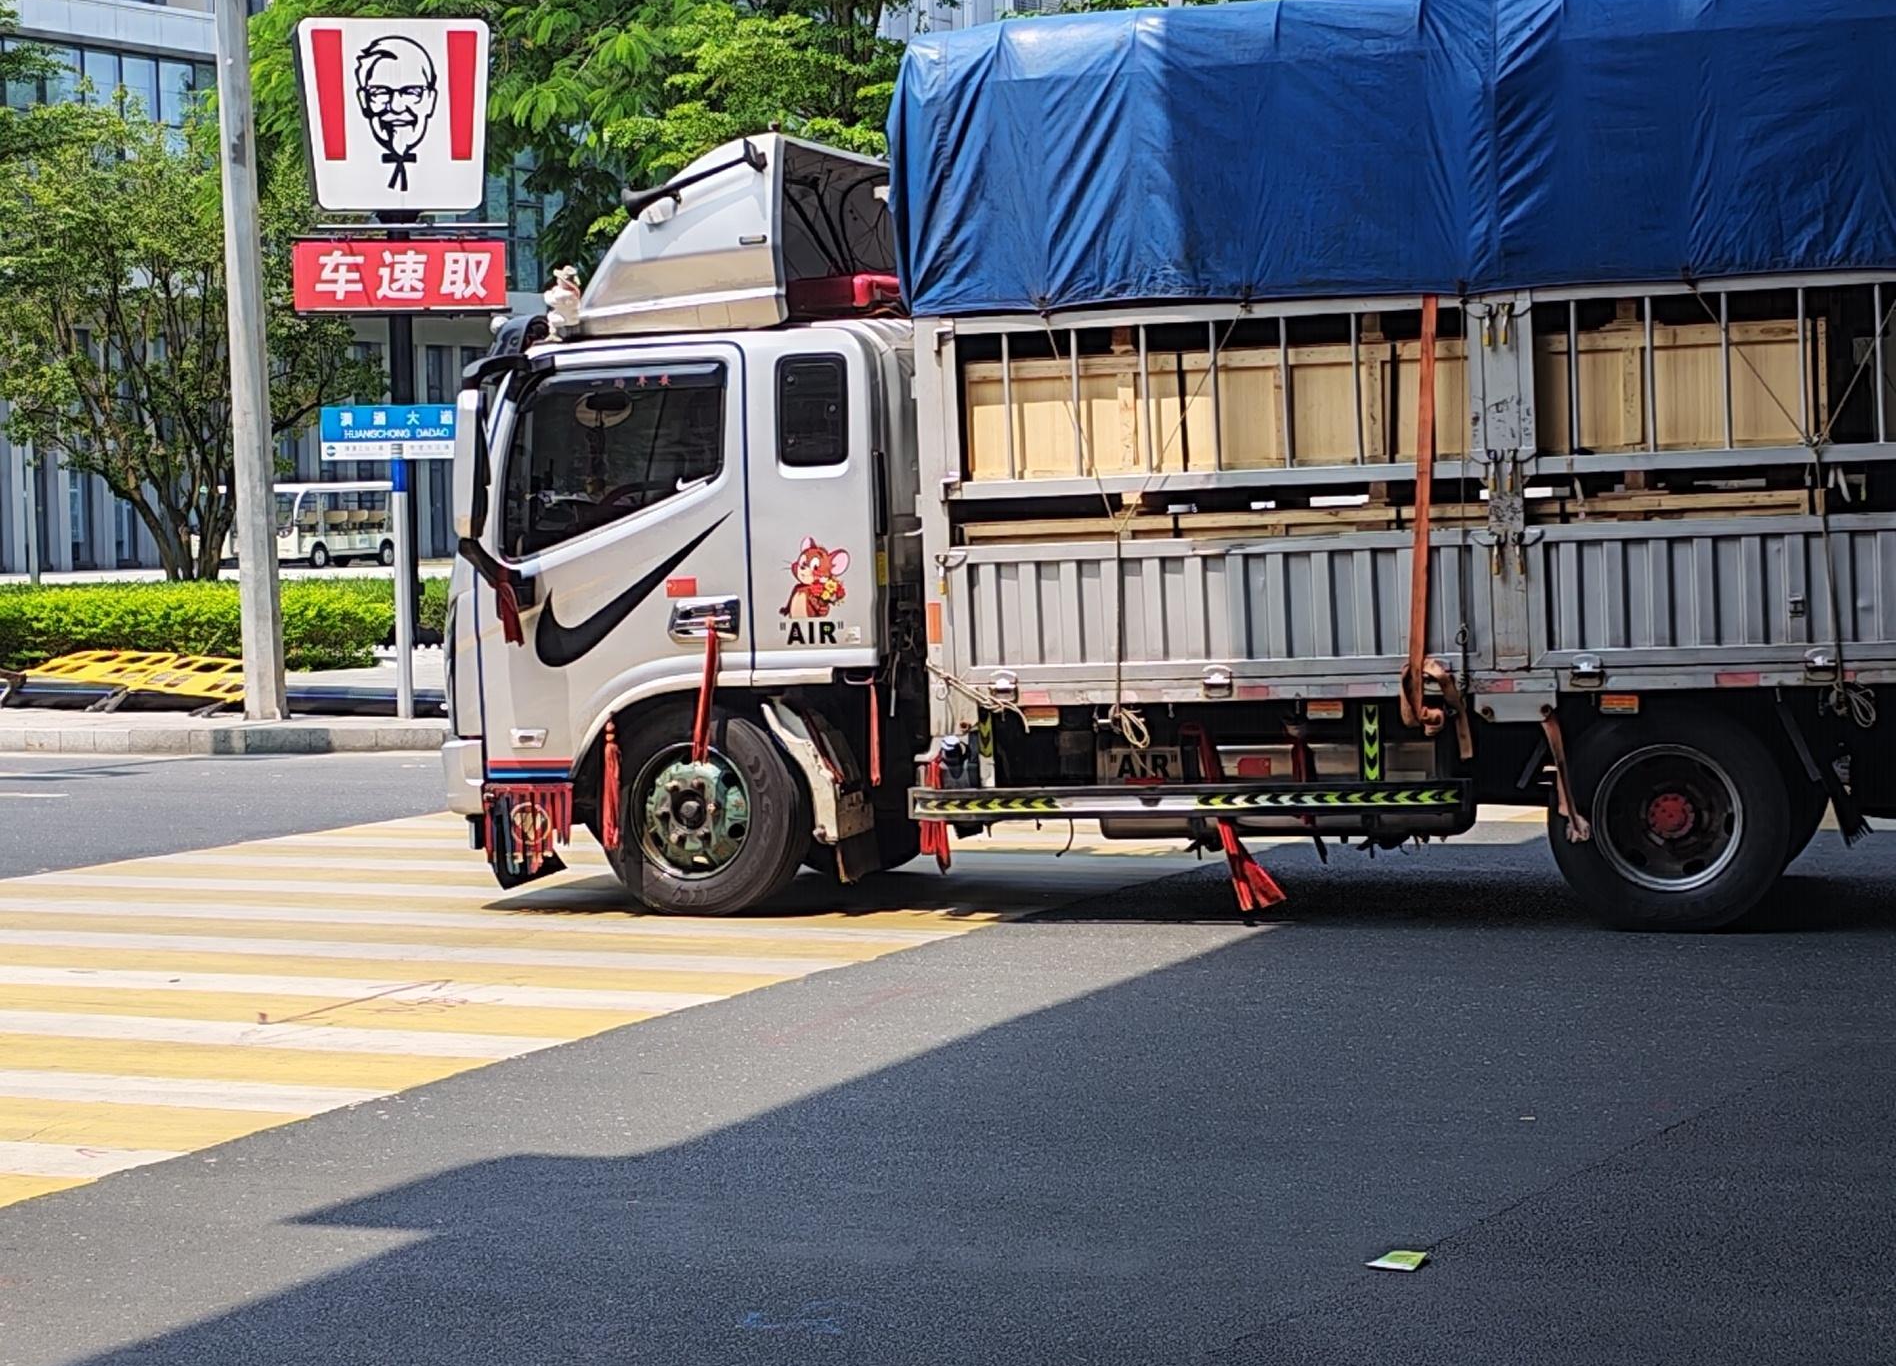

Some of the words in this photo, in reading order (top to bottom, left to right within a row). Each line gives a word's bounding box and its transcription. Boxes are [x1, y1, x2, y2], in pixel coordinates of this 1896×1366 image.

[314, 250, 491, 300] 车速取
[344, 429, 410, 439] HUANGCHONG
[416, 428, 449, 438] DADAO
